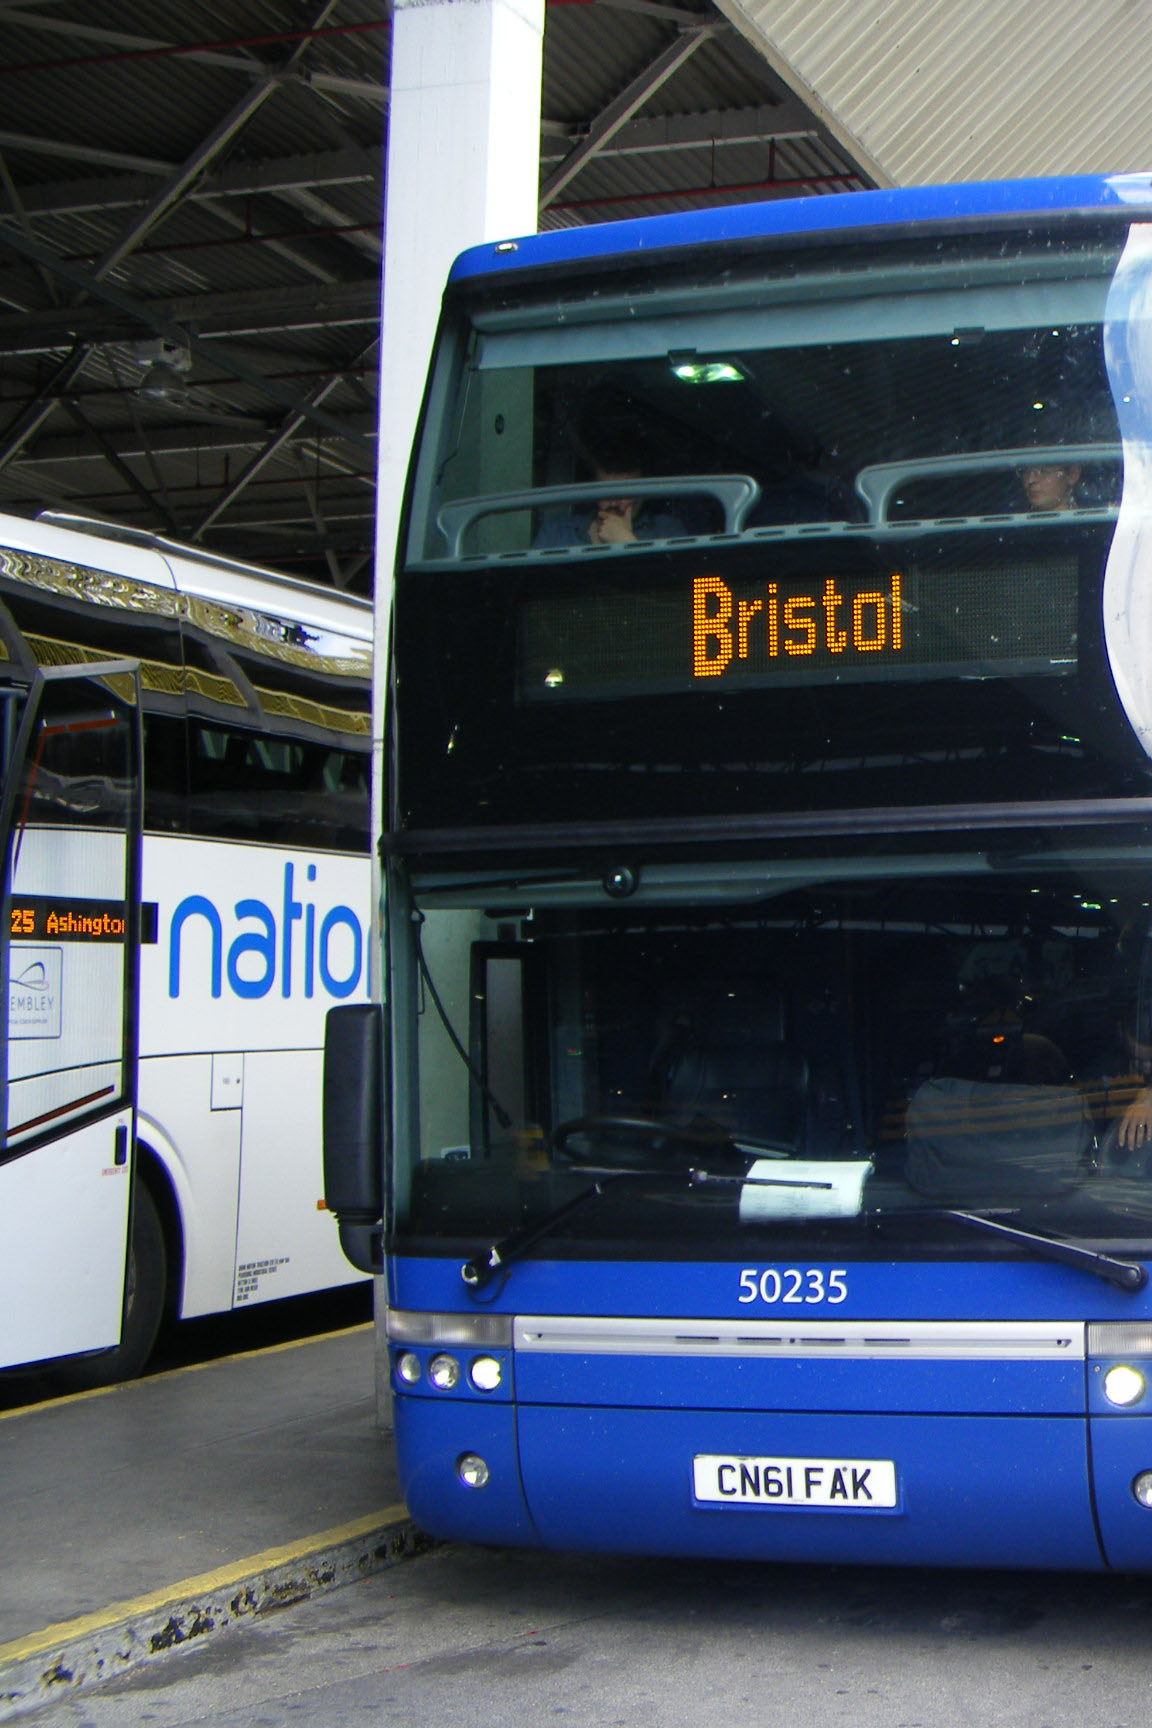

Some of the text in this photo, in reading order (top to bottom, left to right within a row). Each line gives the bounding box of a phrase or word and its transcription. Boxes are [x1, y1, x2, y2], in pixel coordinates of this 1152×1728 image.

[693, 574, 901, 677] Bristol
[168, 861, 372, 999] natio
[10, 996, 55, 1012] EMBLEY
[738, 1269, 848, 1304] 50235
[717, 1464, 873, 1500] CN61 FAK
